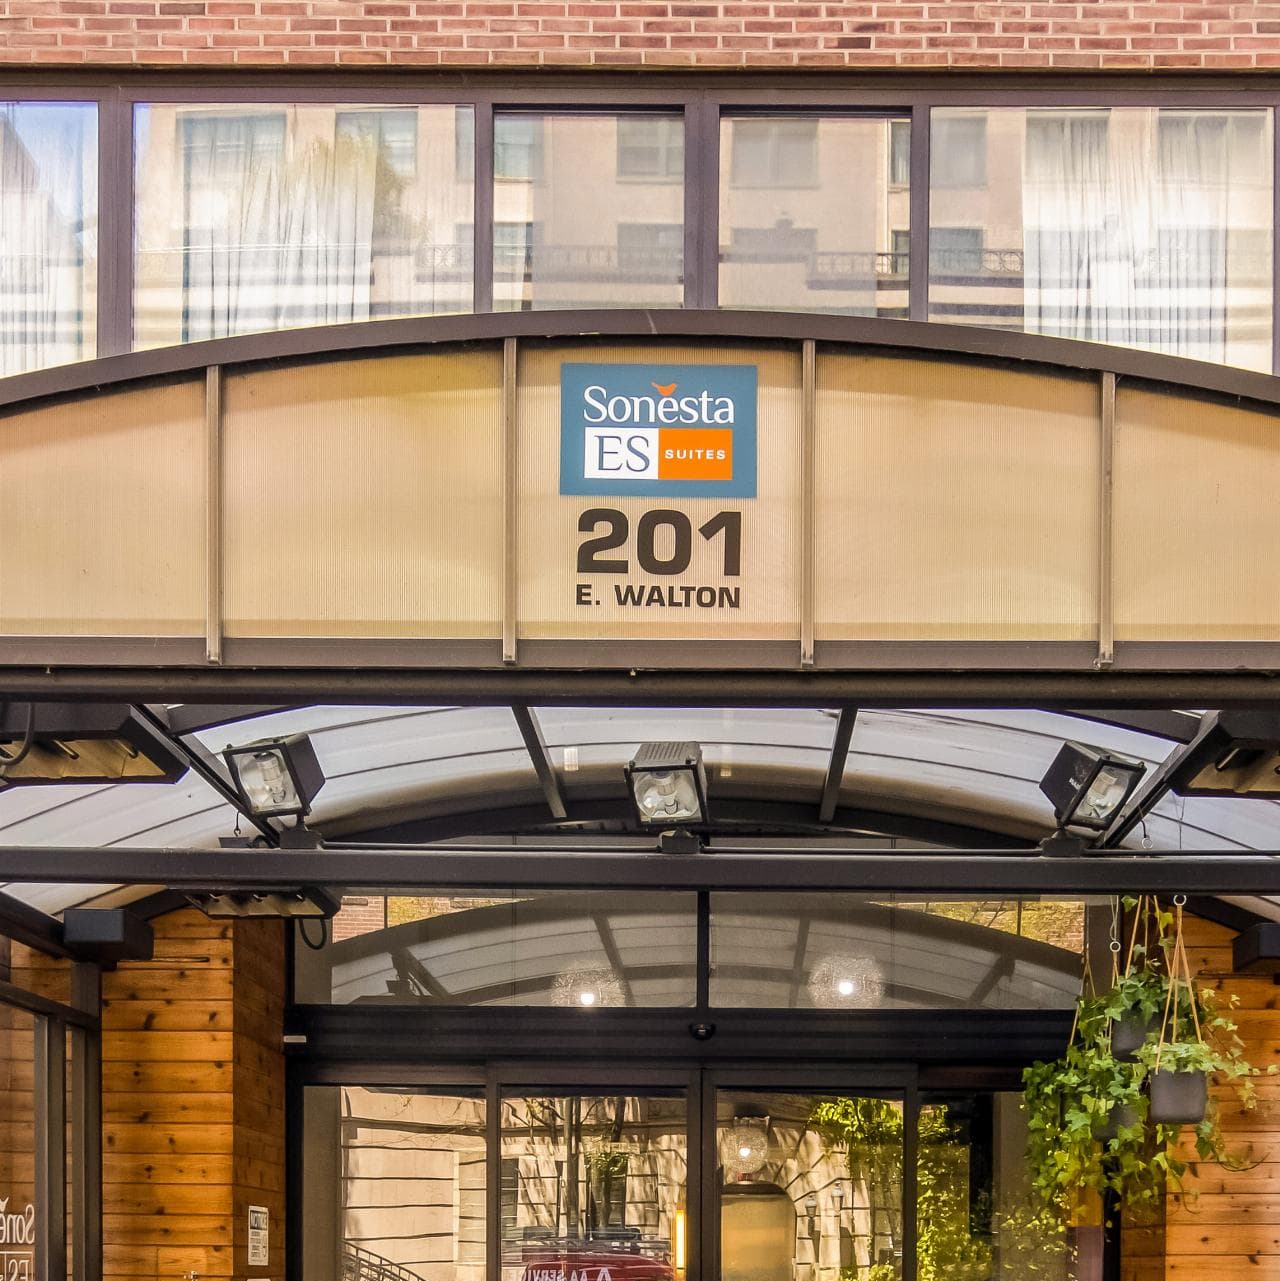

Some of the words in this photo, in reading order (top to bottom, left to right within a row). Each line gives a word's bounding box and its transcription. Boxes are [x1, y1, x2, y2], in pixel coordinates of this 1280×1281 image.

[583, 385, 735, 424] Sonesta
[594, 434, 651, 473] ES
[664, 448, 727, 460] SUITES
[576, 507, 742, 577] 201
[575, 583, 601, 606] E.
[613, 583, 741, 609] WALTON
